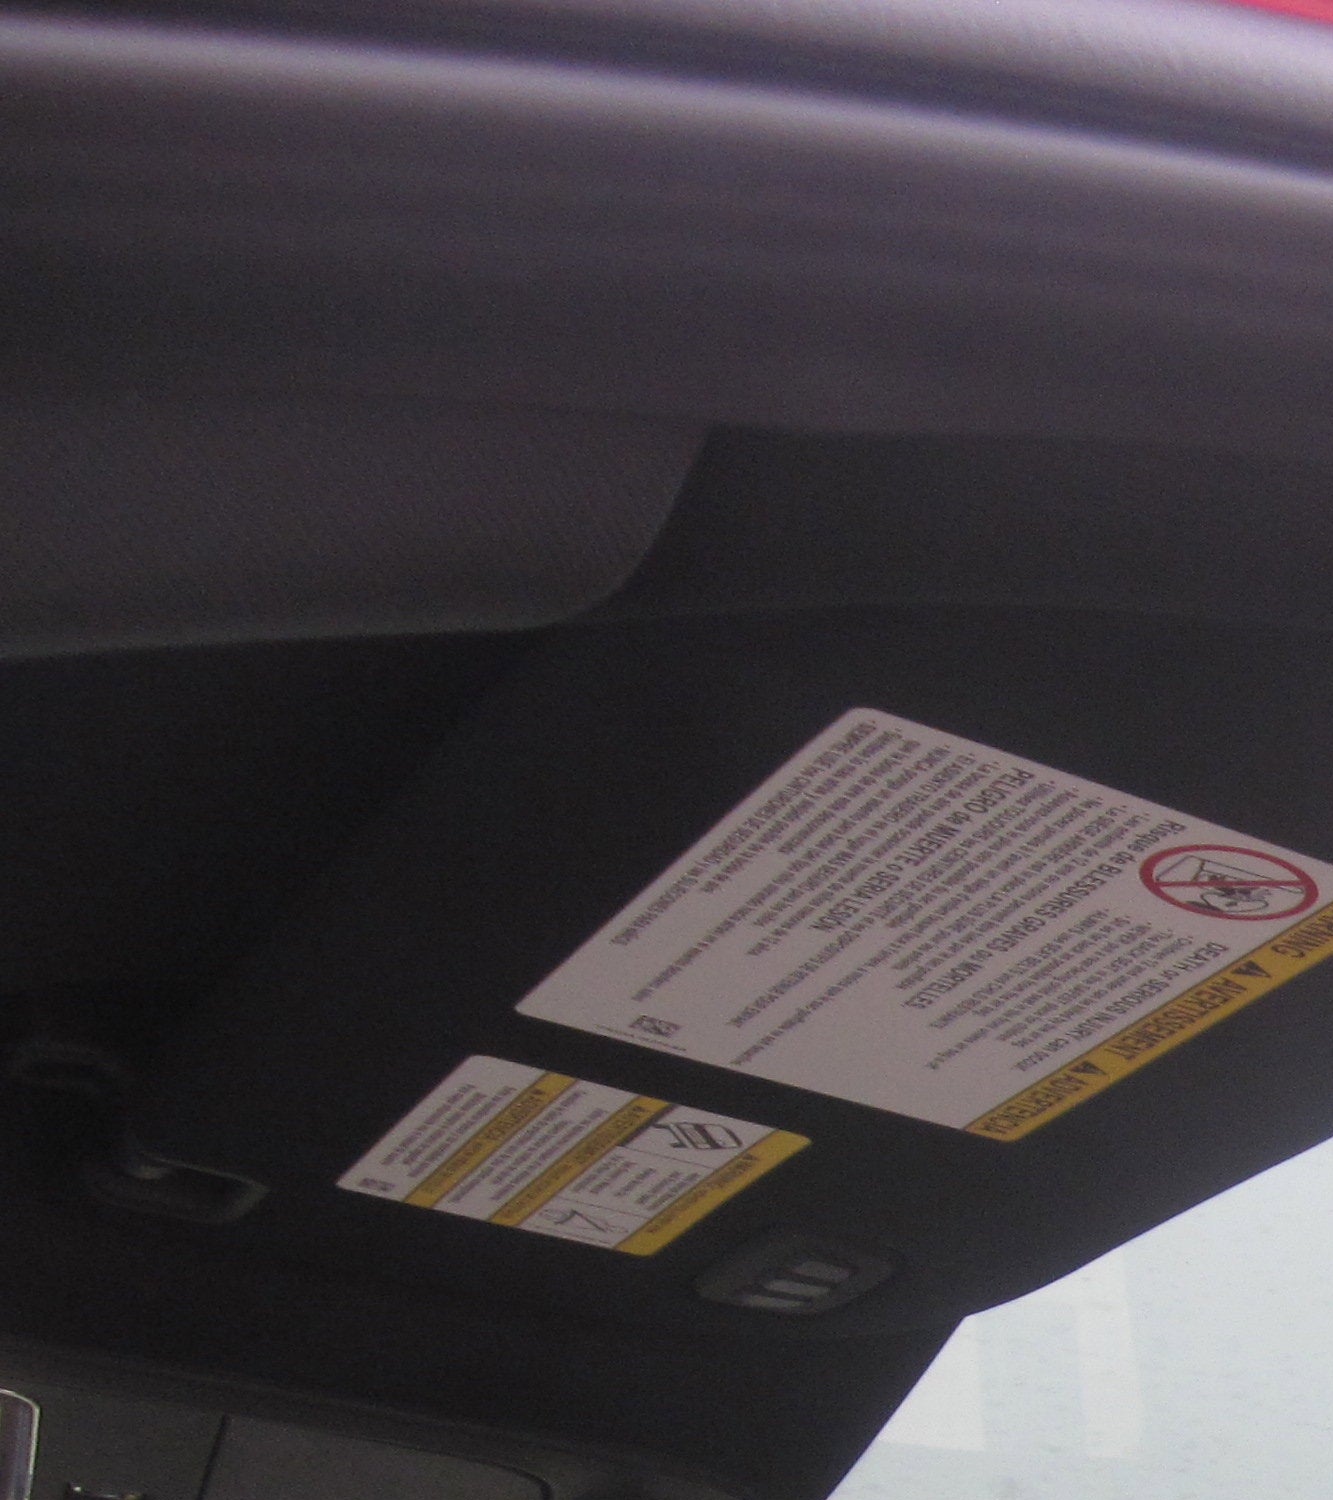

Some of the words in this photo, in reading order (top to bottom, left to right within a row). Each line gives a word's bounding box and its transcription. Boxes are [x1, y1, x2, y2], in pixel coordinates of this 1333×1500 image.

[960, 767, 1035, 815] PELIGRO
[944, 810, 980, 827] de
[894, 823, 963, 867] MUERTE
[1120, 817, 1186, 855] Risque
[1107, 850, 1142, 867] de
[850, 870, 903, 901] SERIA
[1033, 863, 1124, 919] BLESSURES
[984, 915, 1049, 952] GRAVES
[968, 949, 996, 962] ou
[1170, 941, 1229, 972] DEATH
[1155, 968, 1182, 980] or
[1102, 978, 1171, 1015] SERIOUS
[1061, 1011, 1118, 1041] INJURY
[1099, 976, 1252, 1060] AVERTISSEMENT
[1040, 1037, 1072, 1053] can
[973, 1073, 1093, 1135] ADVERTENCIA
